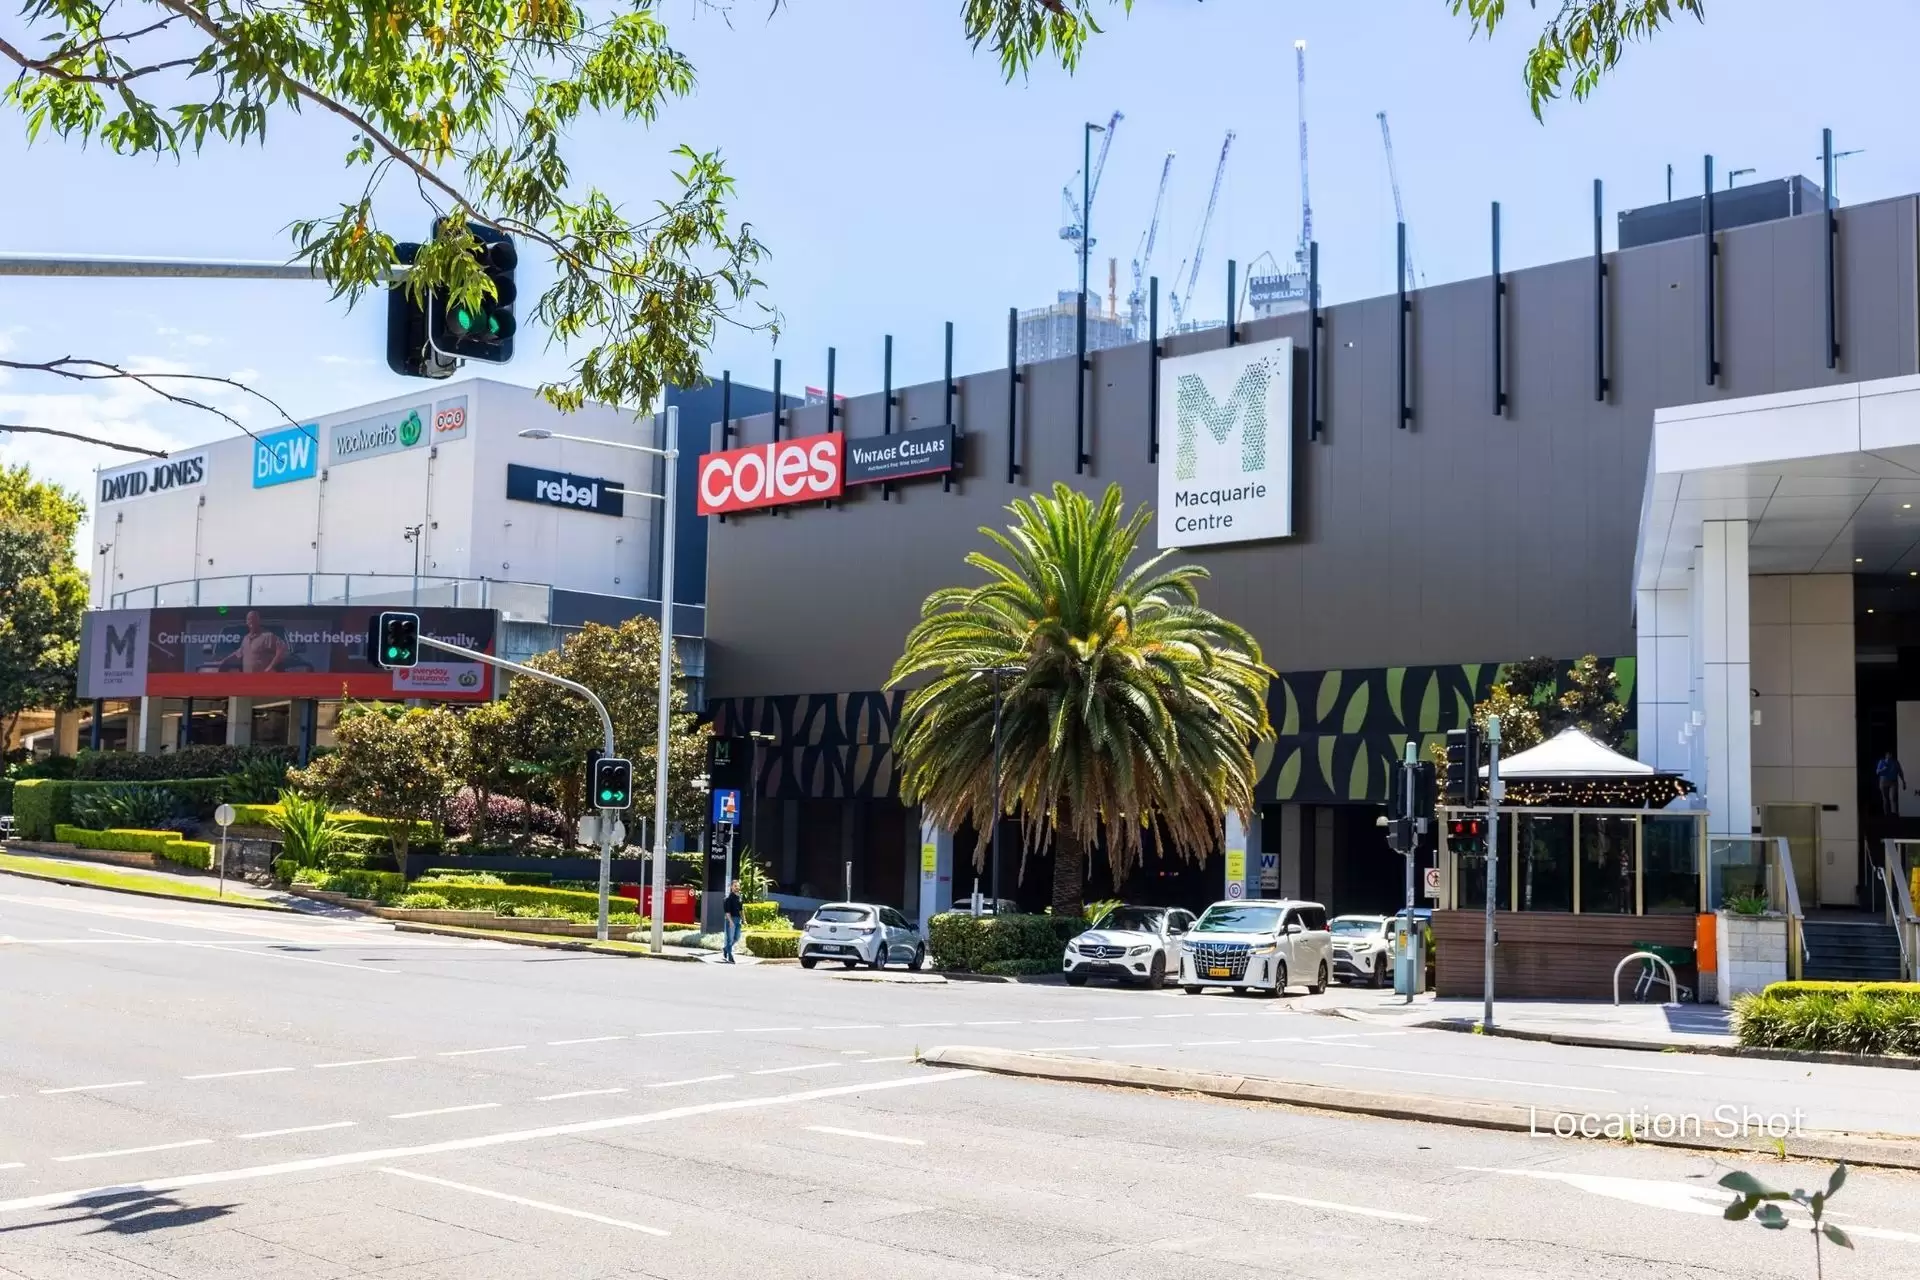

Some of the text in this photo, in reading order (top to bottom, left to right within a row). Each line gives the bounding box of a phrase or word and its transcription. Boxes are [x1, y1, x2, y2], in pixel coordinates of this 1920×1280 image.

[1250, 289, 1304, 301] NOW SELLING
[100, 456, 204, 503] DAVID JONES
[701, 440, 837, 507] coles
[536, 478, 598, 508] rebel
[1175, 482, 1267, 508] Macquarie
[1175, 514, 1234, 533] Centre
[157, 632, 179, 644] Car
[180, 631, 241, 644] insurance
[288, 631, 320, 643] that
[322, 631, 361, 647] helps
